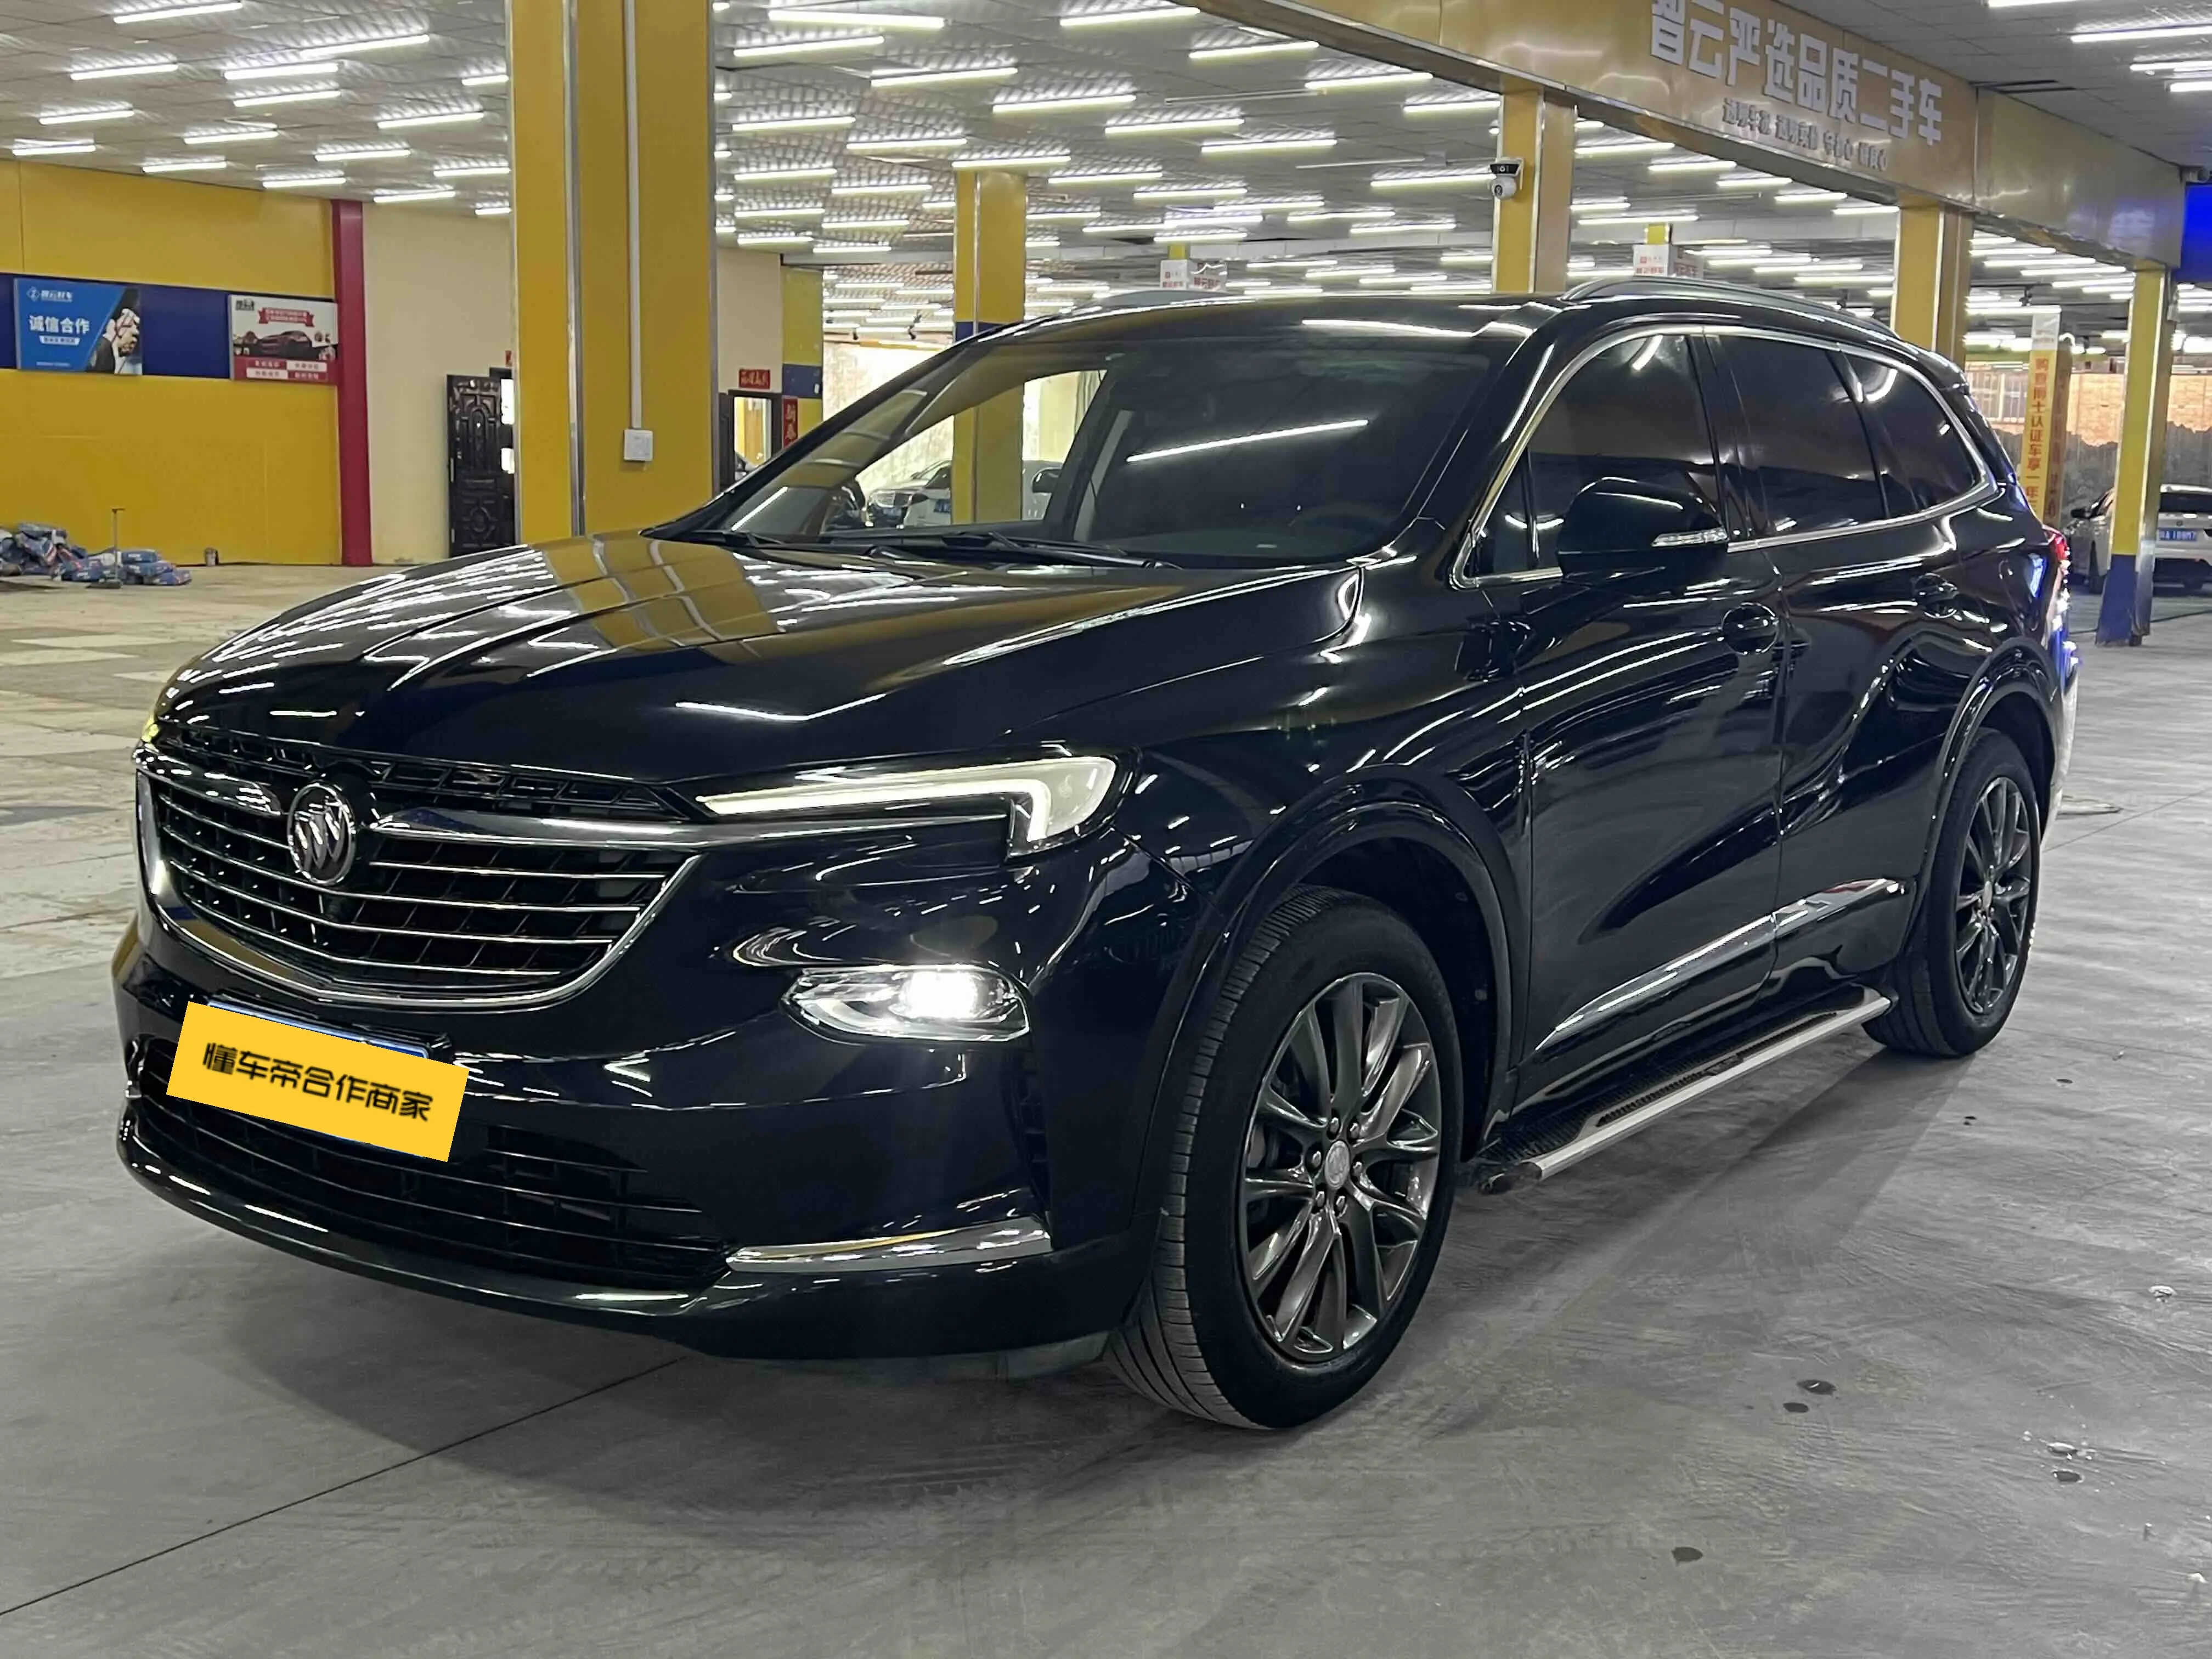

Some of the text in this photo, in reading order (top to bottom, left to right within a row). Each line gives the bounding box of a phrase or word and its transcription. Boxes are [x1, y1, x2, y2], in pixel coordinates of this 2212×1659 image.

[1651, 0, 1942, 145] 智云严选品质二手车
[29, 315, 90, 334] 诚信合作
